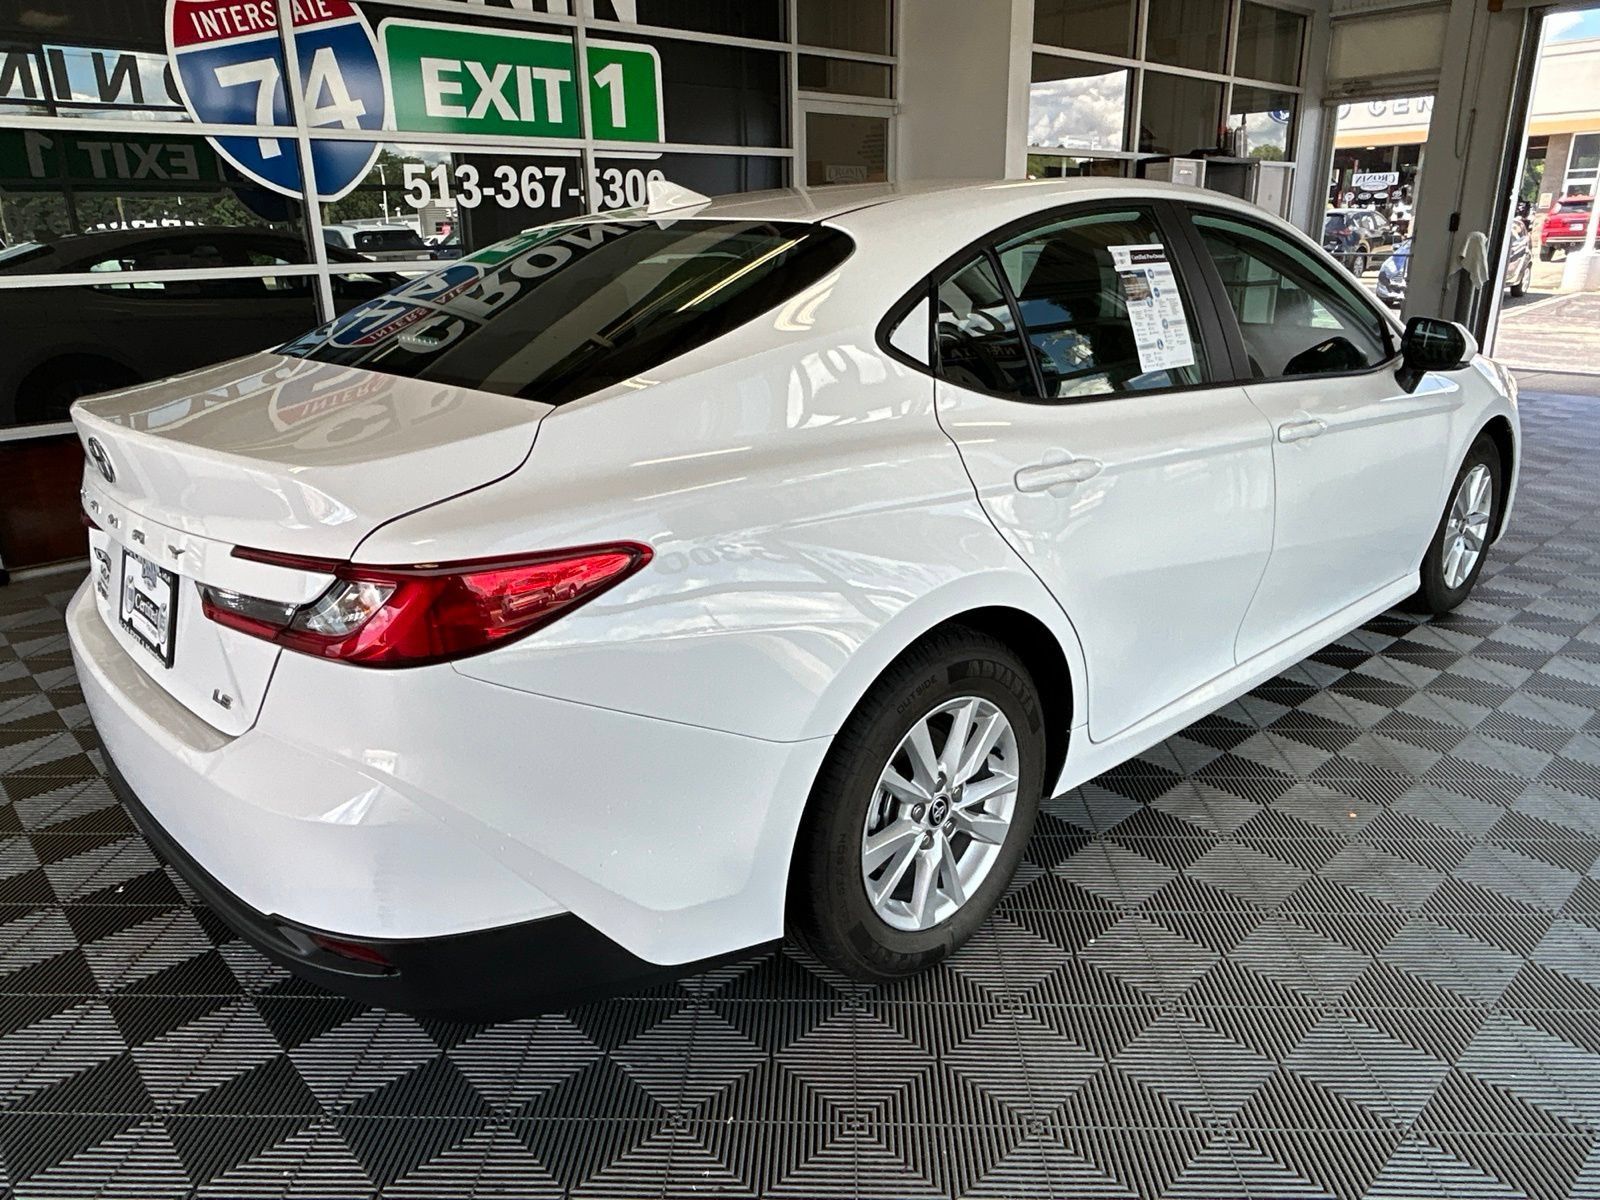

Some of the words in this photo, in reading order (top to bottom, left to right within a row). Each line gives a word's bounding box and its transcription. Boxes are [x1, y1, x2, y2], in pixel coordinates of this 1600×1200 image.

[214, 46, 367, 160] 74
[420, 57, 572, 124] EXIT
[593, 63, 627, 129] 1
[212, 688, 234, 711] LE
[896, 674, 939, 714] OUTSIDE
